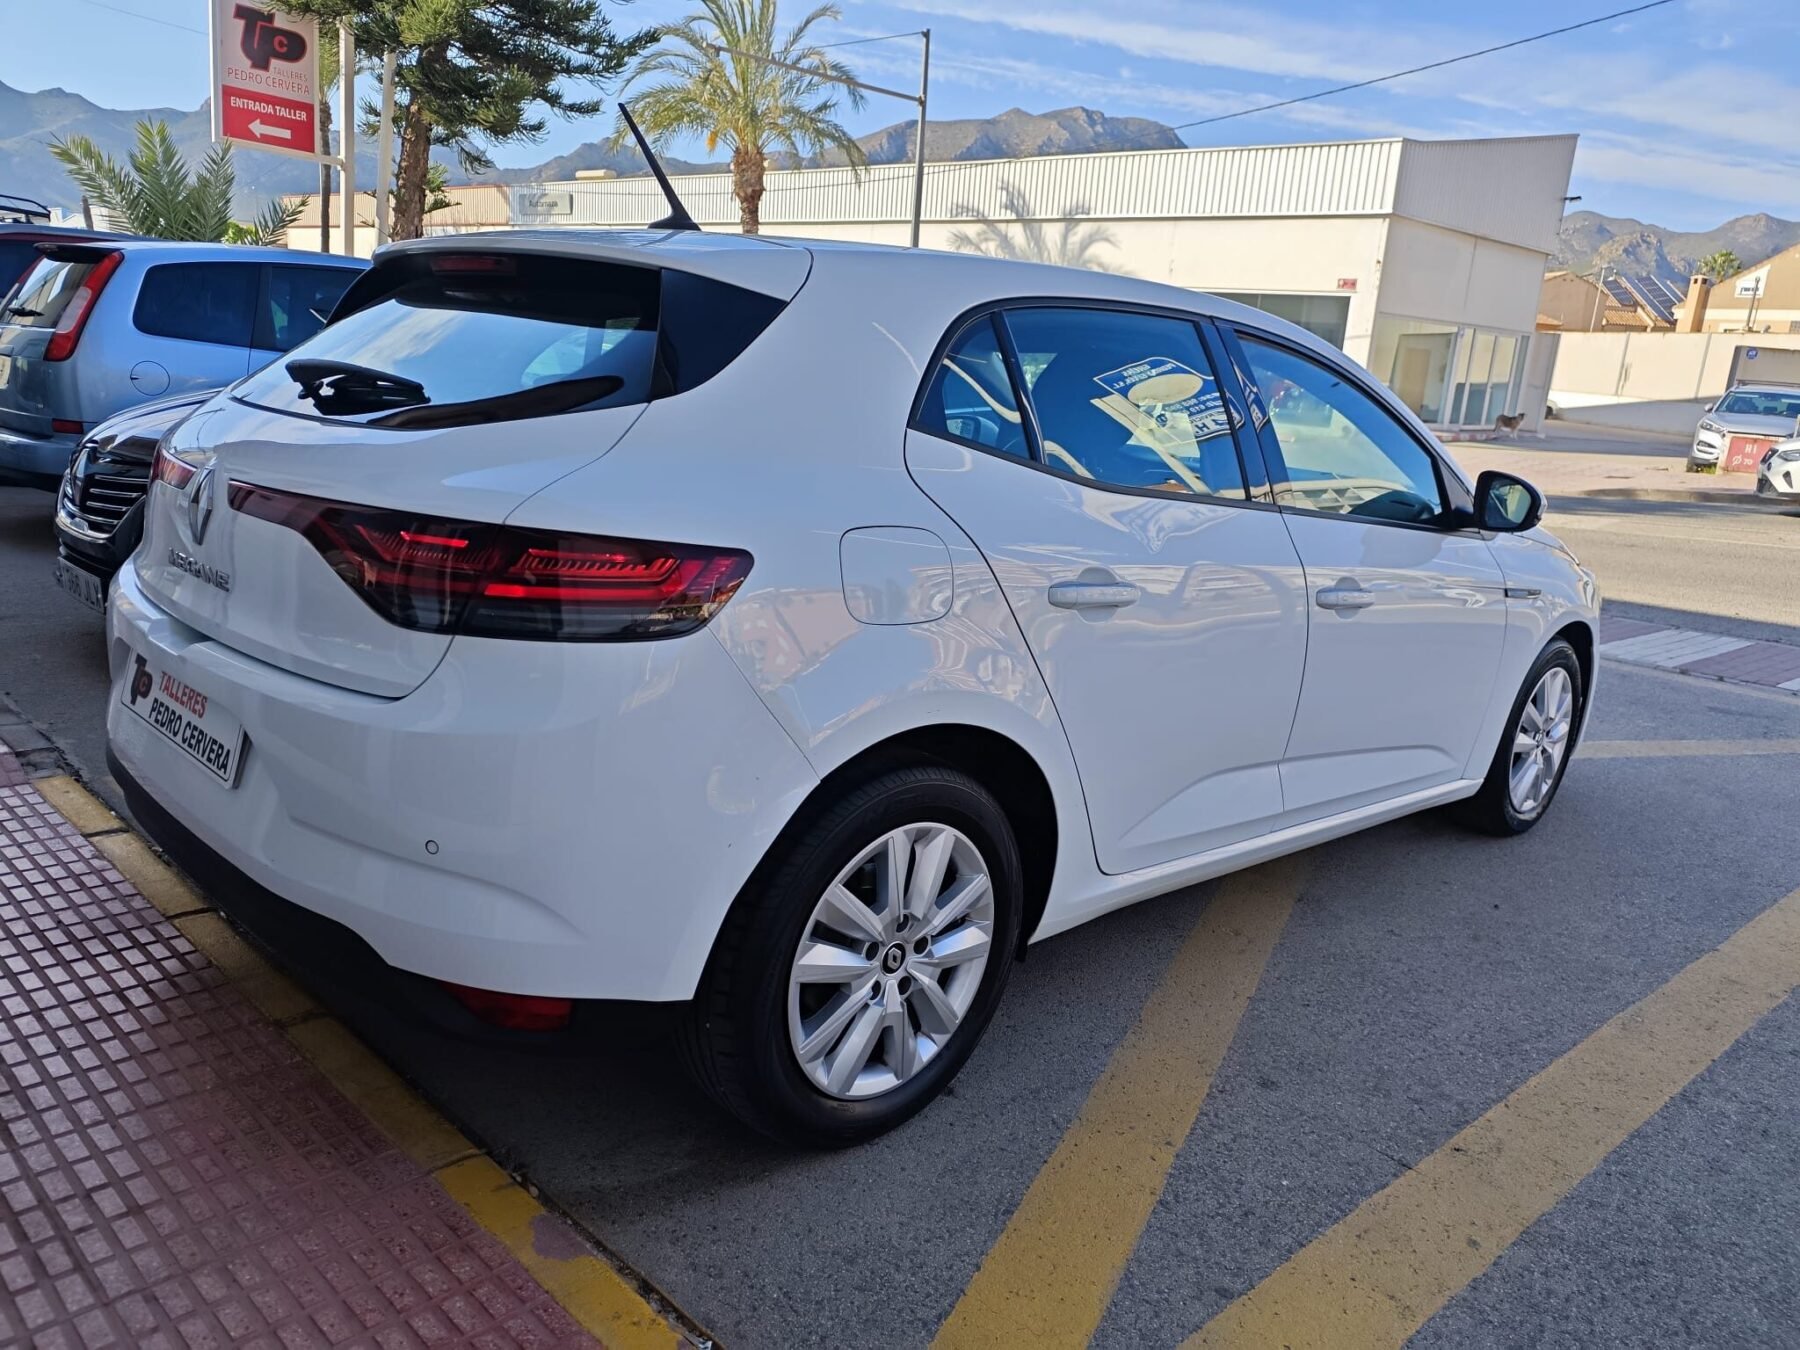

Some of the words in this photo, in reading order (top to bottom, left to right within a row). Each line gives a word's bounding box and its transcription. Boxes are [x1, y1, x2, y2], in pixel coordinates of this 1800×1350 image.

[227, 67, 263, 85] PEDRO
[265, 75, 310, 96] CERVERA
[273, 66, 308, 82] TALLERES
[230, 96, 274, 115] ENTRADA
[275, 105, 307, 121] TALLER
[159, 670, 208, 719] TALLERES
[148, 697, 183, 738] PEDRO
[181, 721, 231, 775] CERVERA
